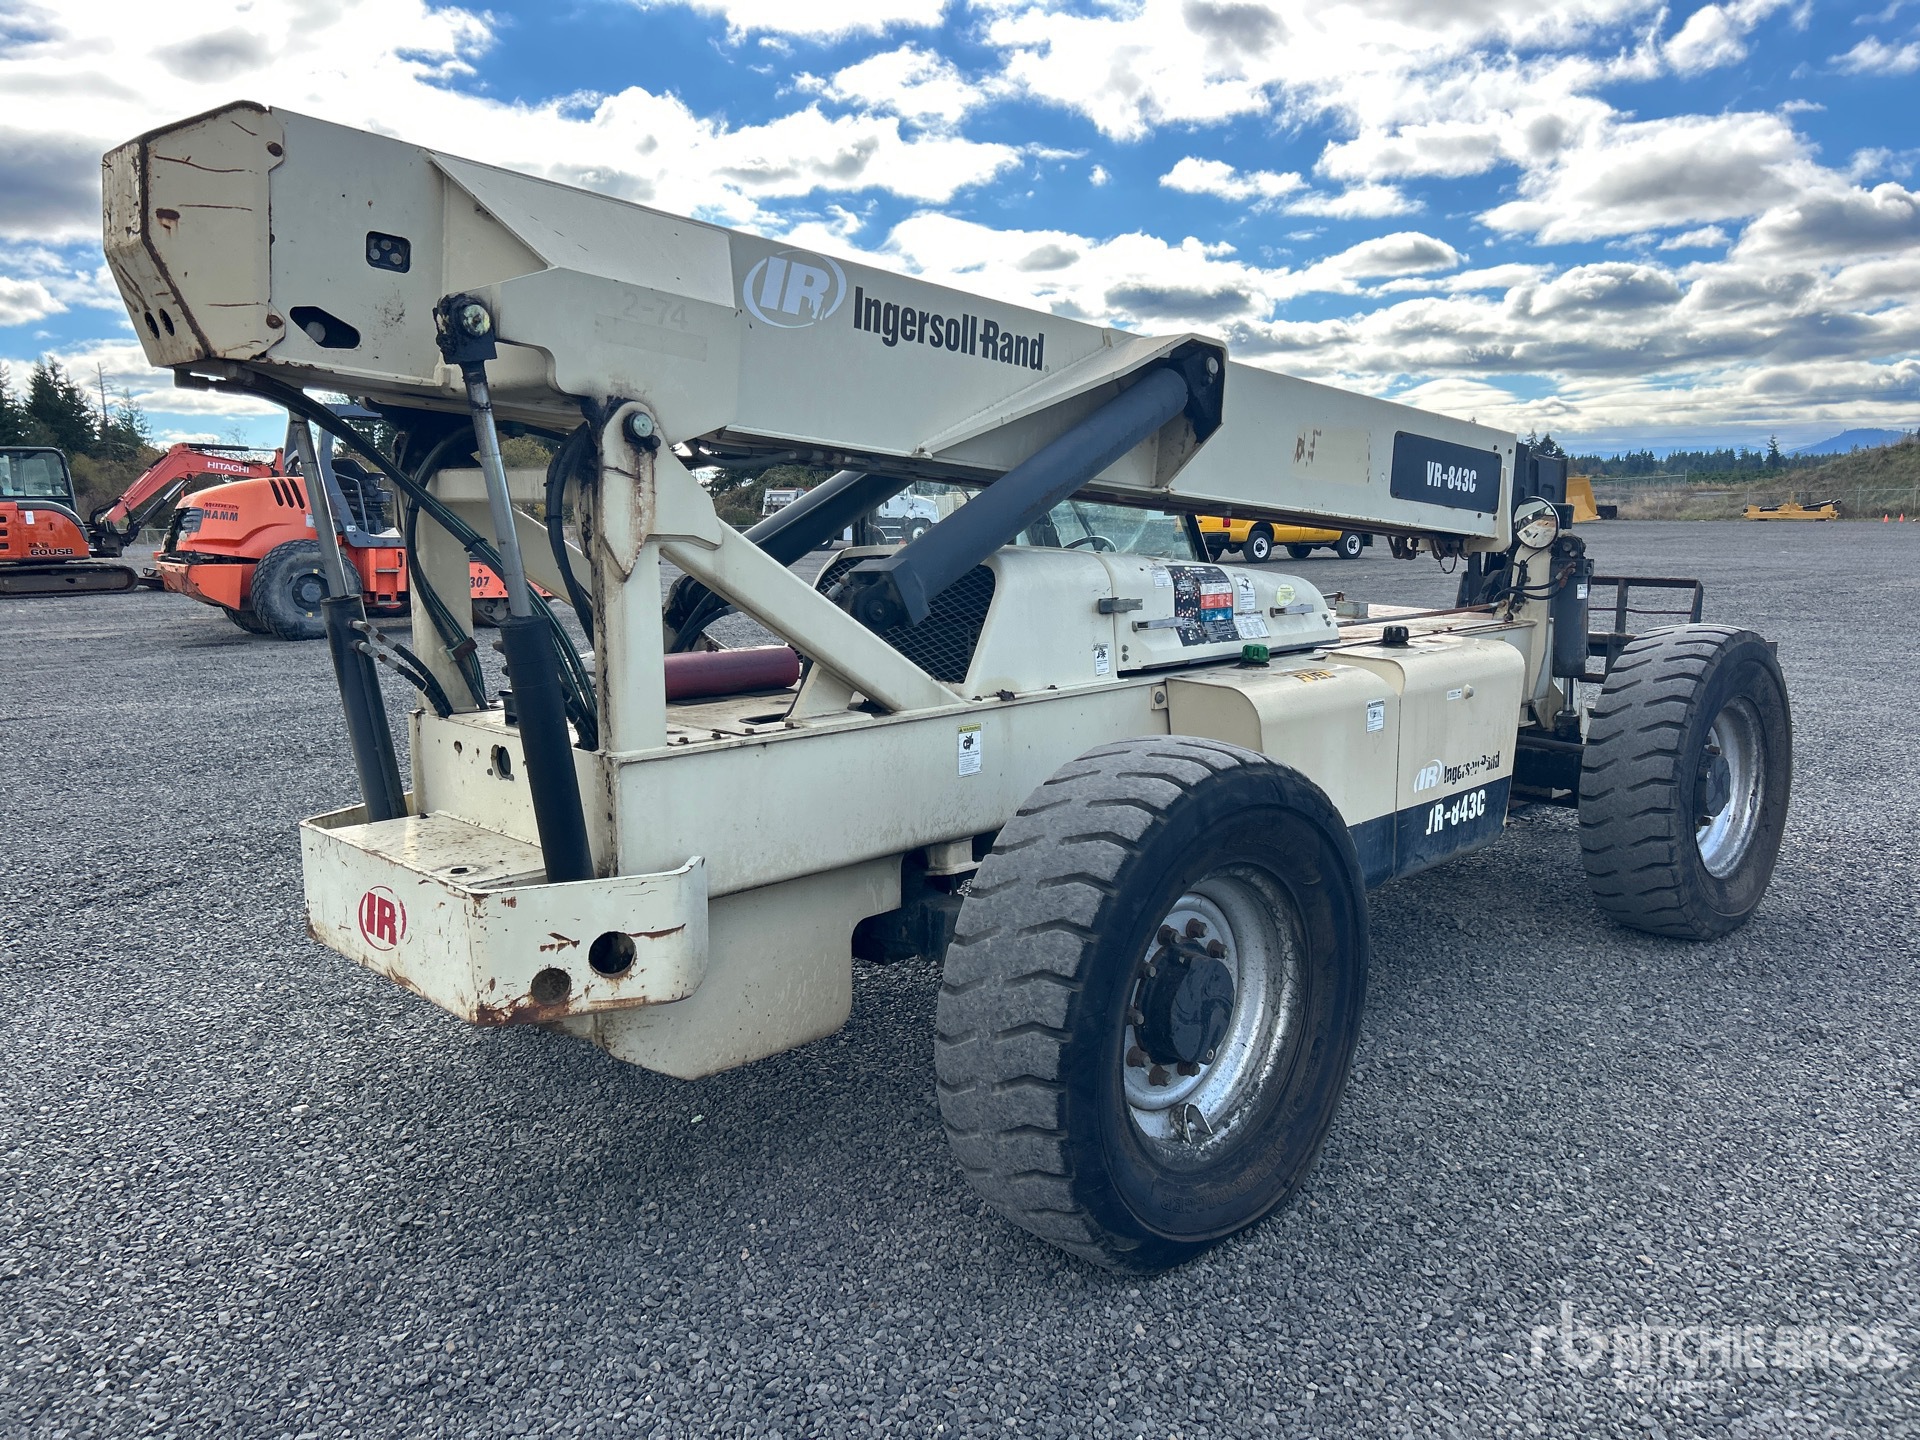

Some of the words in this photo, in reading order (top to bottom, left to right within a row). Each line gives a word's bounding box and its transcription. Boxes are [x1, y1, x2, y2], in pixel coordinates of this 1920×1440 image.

[760, 256, 830, 320] IR
[207, 461, 250, 474] HITACHI
[1426, 460, 1477, 493] VR-843C
[203, 509, 239, 521] HAMM
[30, 548, 74, 556] 60USB
[1418, 765, 1439, 791] IR
[367, 891, 398, 946] IR
